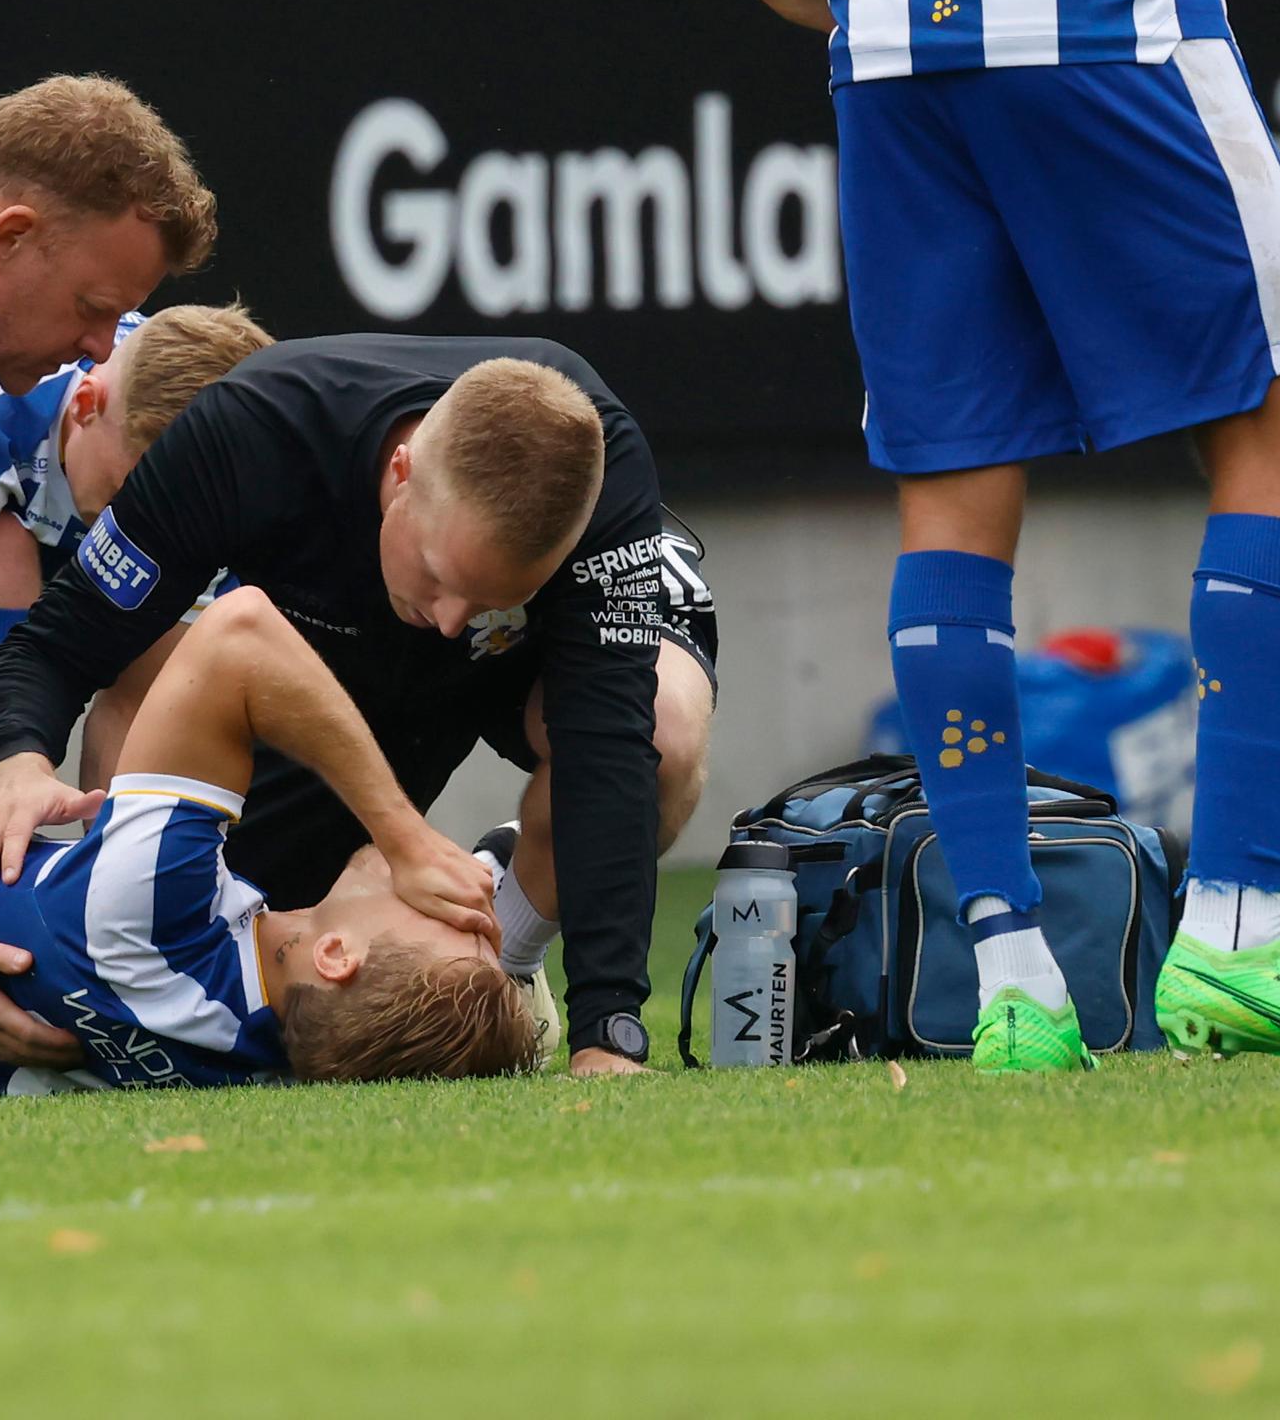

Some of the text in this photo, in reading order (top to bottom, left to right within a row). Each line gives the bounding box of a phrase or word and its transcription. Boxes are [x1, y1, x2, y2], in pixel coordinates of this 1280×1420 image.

[328, 90, 843, 322] Gamla
[91, 517, 152, 588] UNIBET
[599, 627, 661, 647] MOBILL
[606, 600, 657, 613] NORDIC
[769, 962, 788, 1066] MAURTEN
